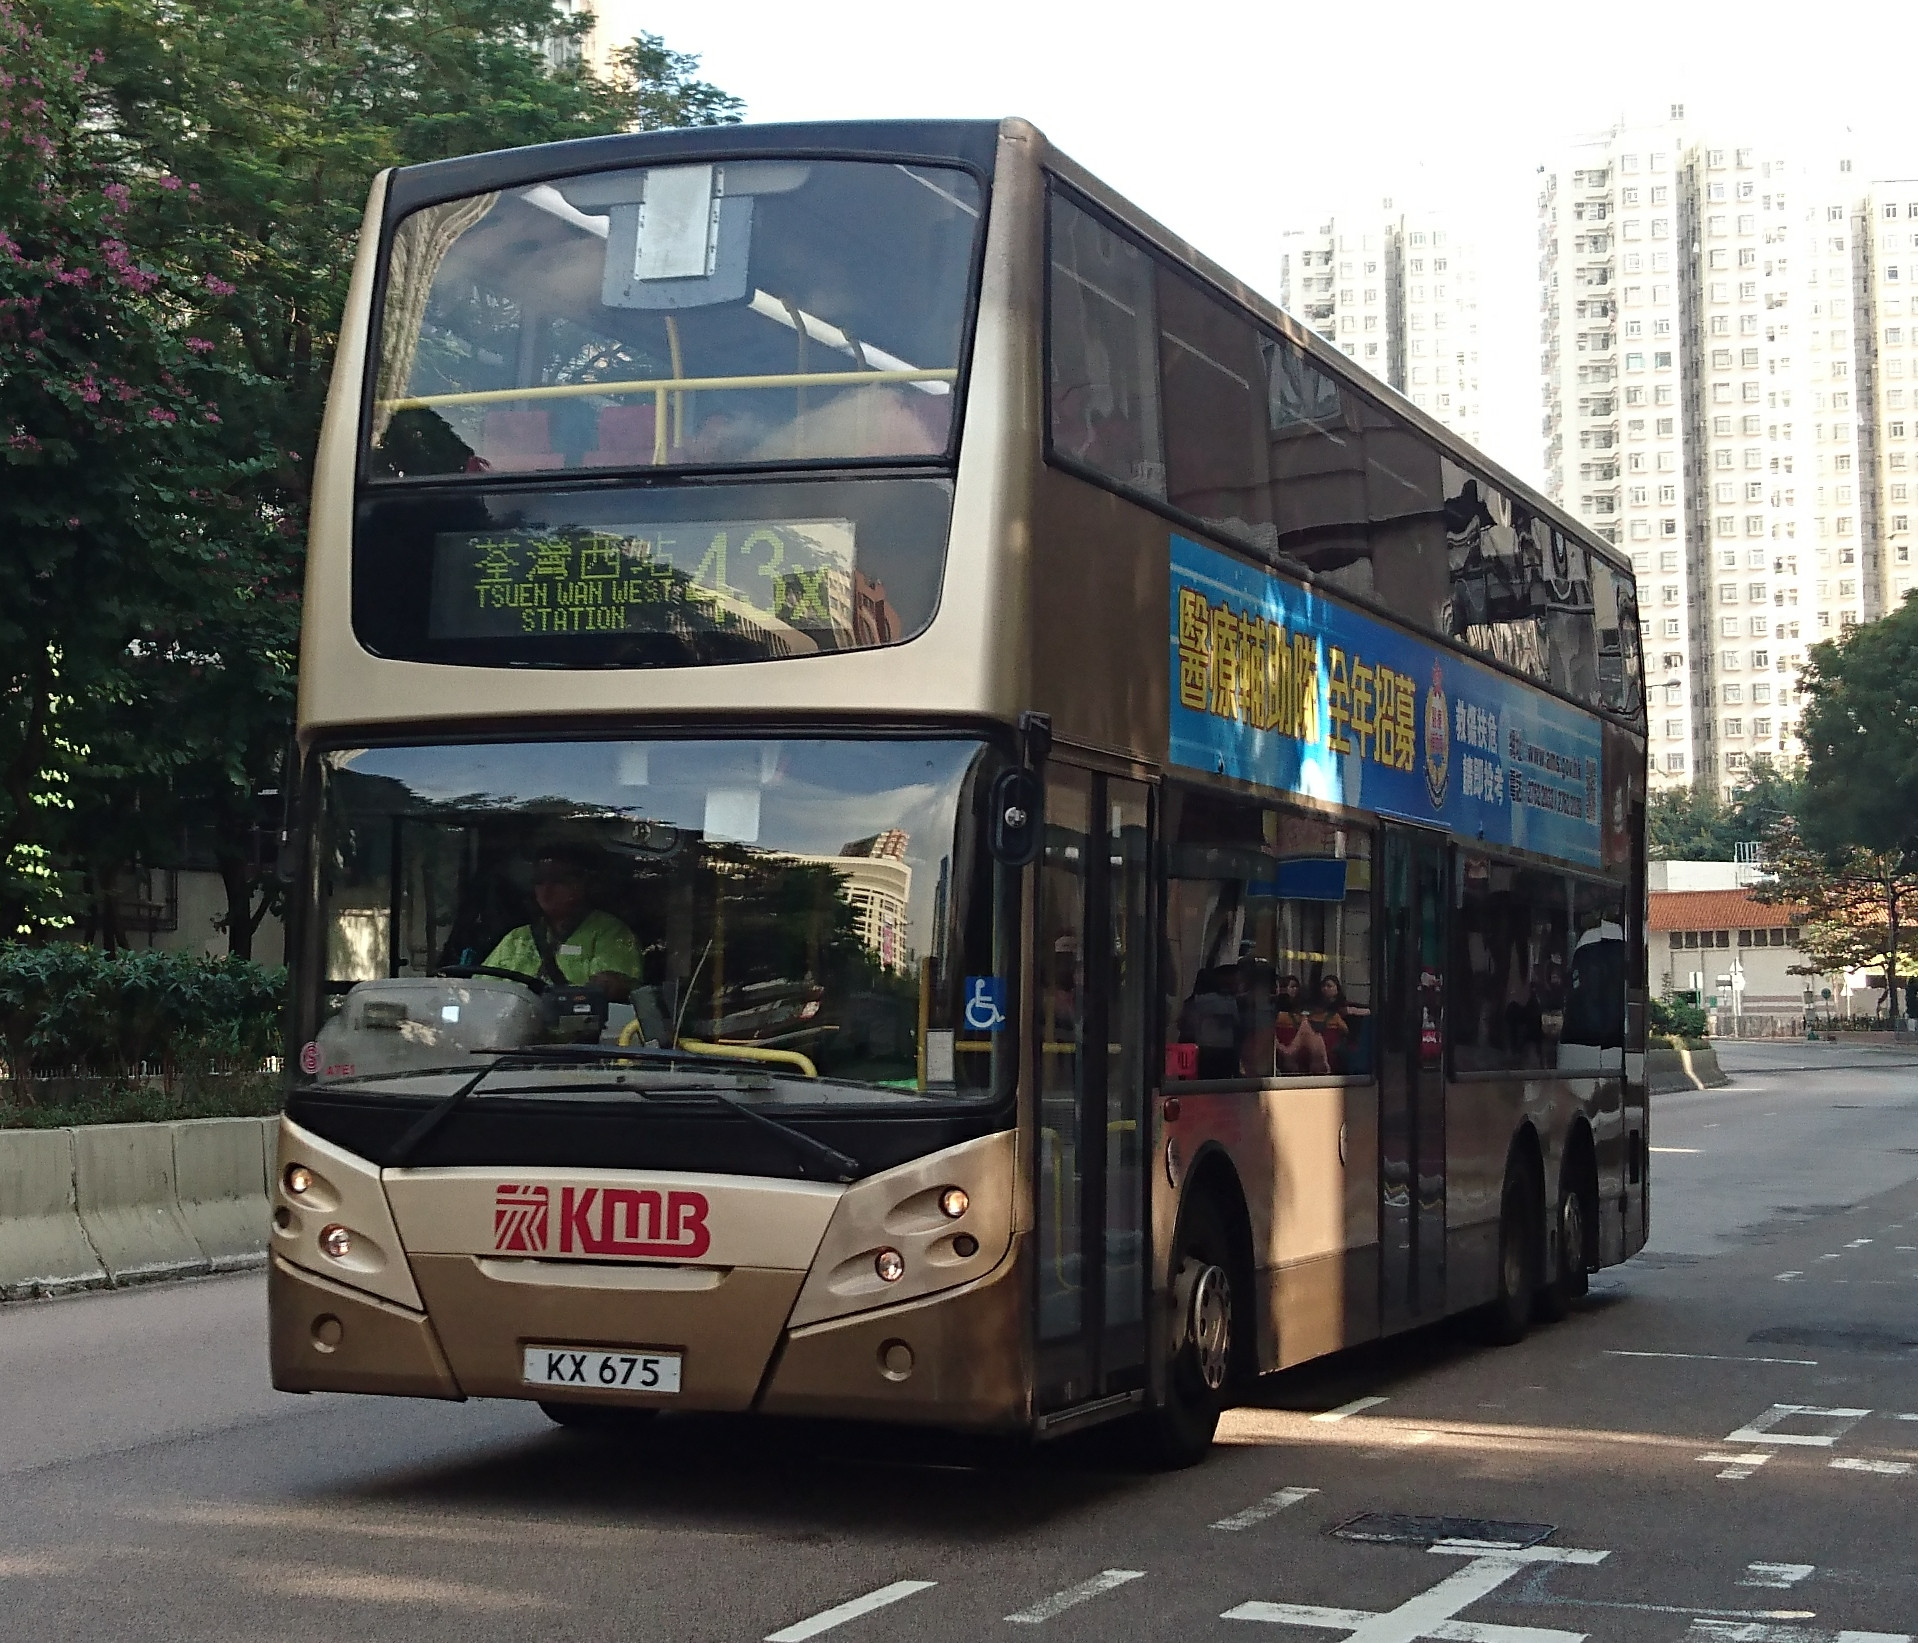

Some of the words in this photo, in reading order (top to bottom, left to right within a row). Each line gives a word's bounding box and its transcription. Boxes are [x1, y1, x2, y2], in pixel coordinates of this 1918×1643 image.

[474, 583, 548, 608] TSUEN
[555, 580, 602, 605] WAN
[611, 578, 676, 604] WEST
[521, 605, 627, 632] STATION
[1327, 645, 1417, 773] 全年招募
[559, 1186, 711, 1259] KMB
[547, 1353, 587, 1383] KX
[599, 1356, 660, 1388] 675
